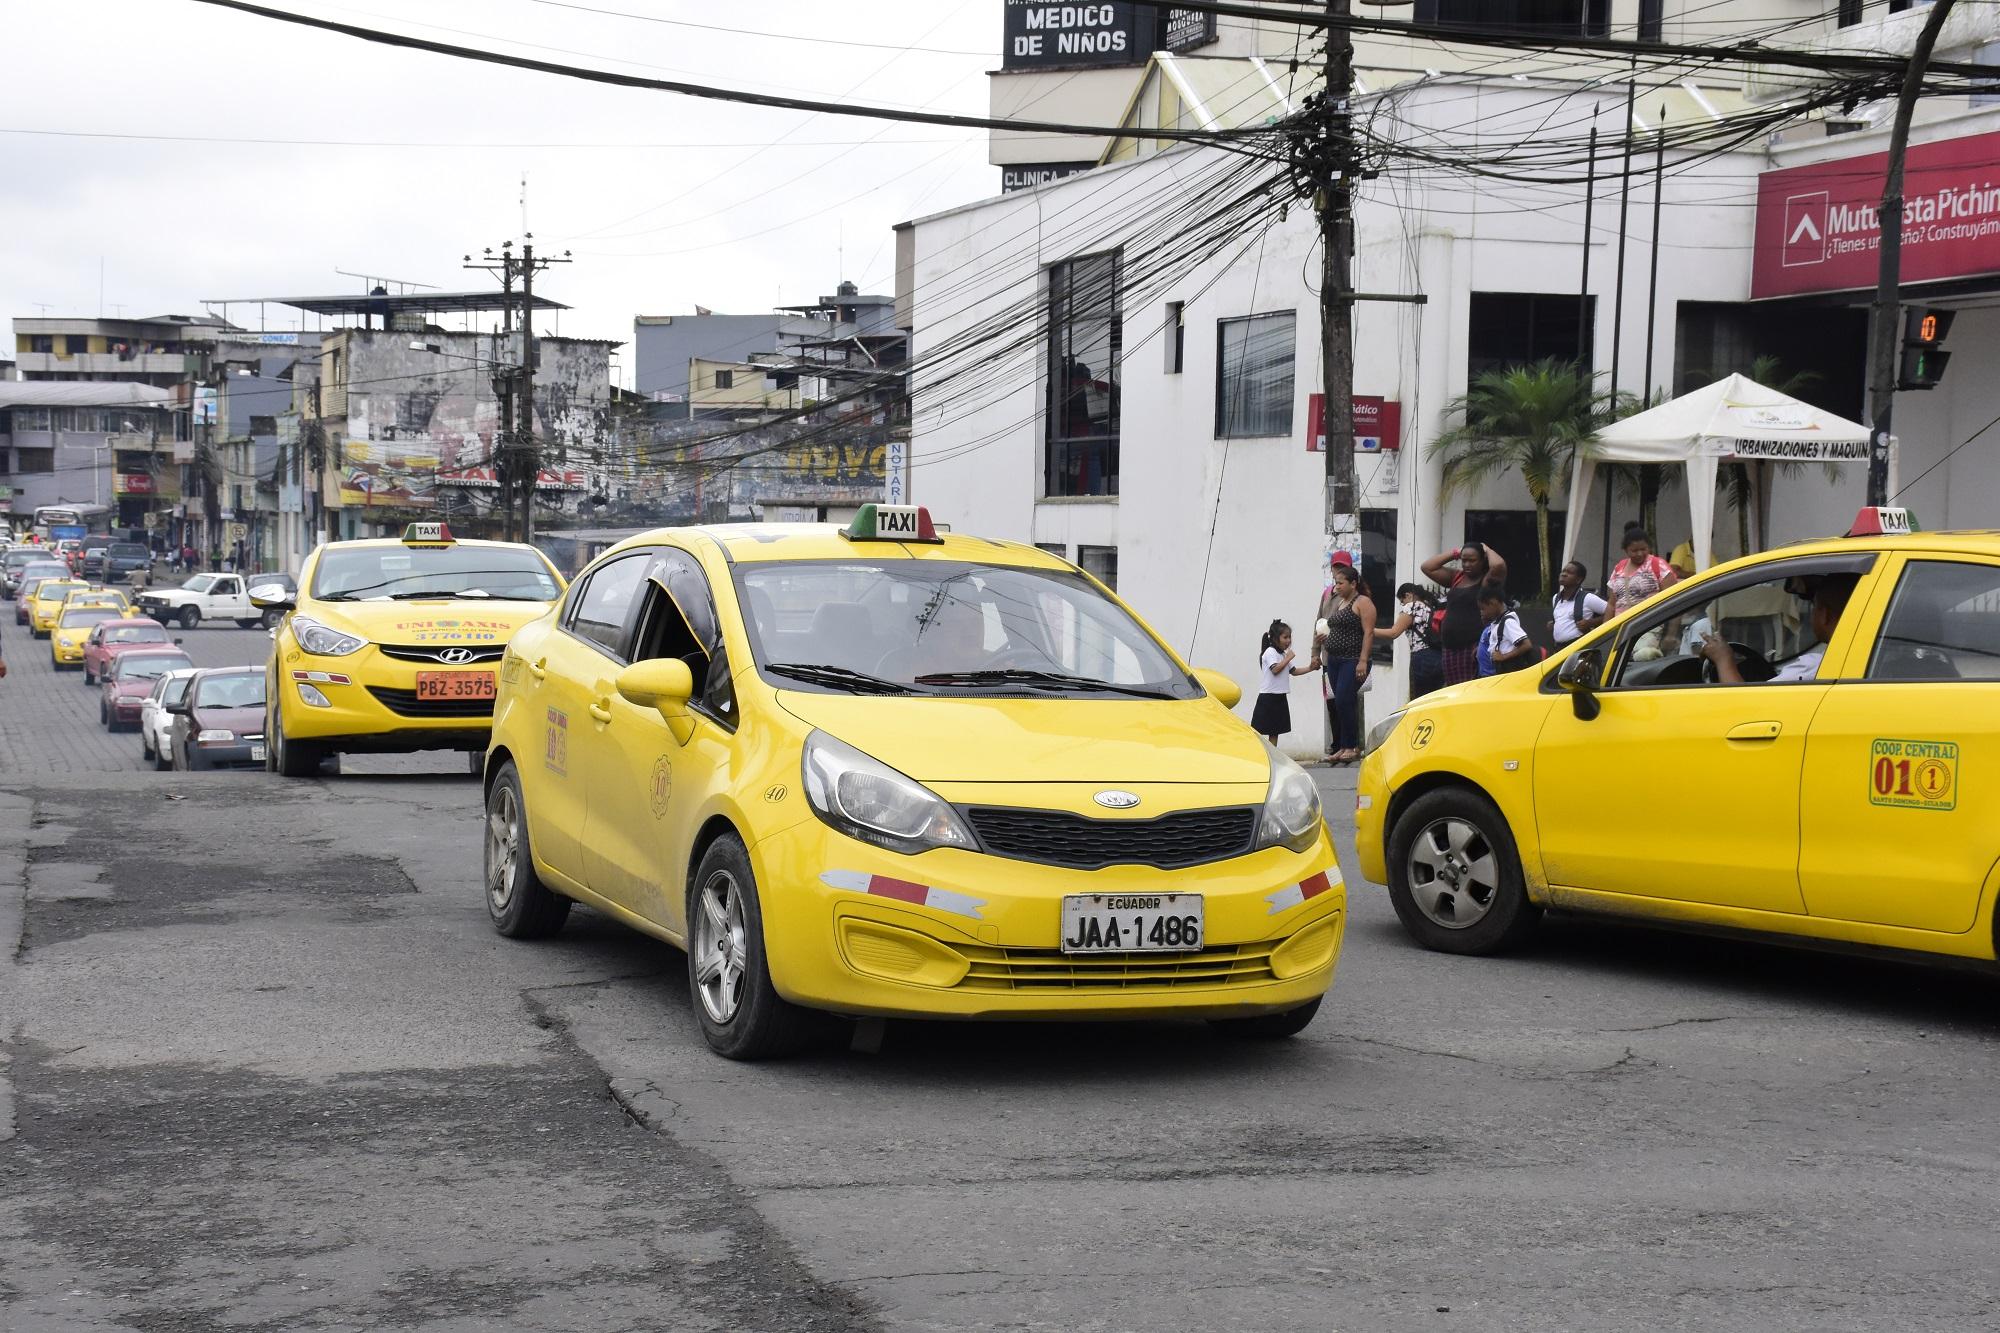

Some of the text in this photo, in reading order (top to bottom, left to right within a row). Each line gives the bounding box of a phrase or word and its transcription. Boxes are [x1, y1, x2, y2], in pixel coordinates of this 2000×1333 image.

[1026, 5, 1114, 29] MEDICO
[1015, 30, 1127, 56] DE NIÑOS
[1005, 171, 1058, 187] CLINICA
[1735, 438, 1819, 458] URBANIZACIONES
[1822, 443, 1828, 458] Y
[417, 527, 440, 535] TAXI
[878, 512, 916, 532] TAXI
[1880, 513, 1909, 530] TAXI
[419, 680, 493, 696] PBZ-3575
[1413, 725, 1432, 746] 72
[1905, 743, 1956, 759] CENTRAL
[1874, 757, 1914, 797] 01
[1927, 768, 1937, 790] 1
[766, 786, 785, 801] 40
[1107, 897, 1161, 910] ECUADOR
[1065, 915, 1199, 949] JAA-1486
